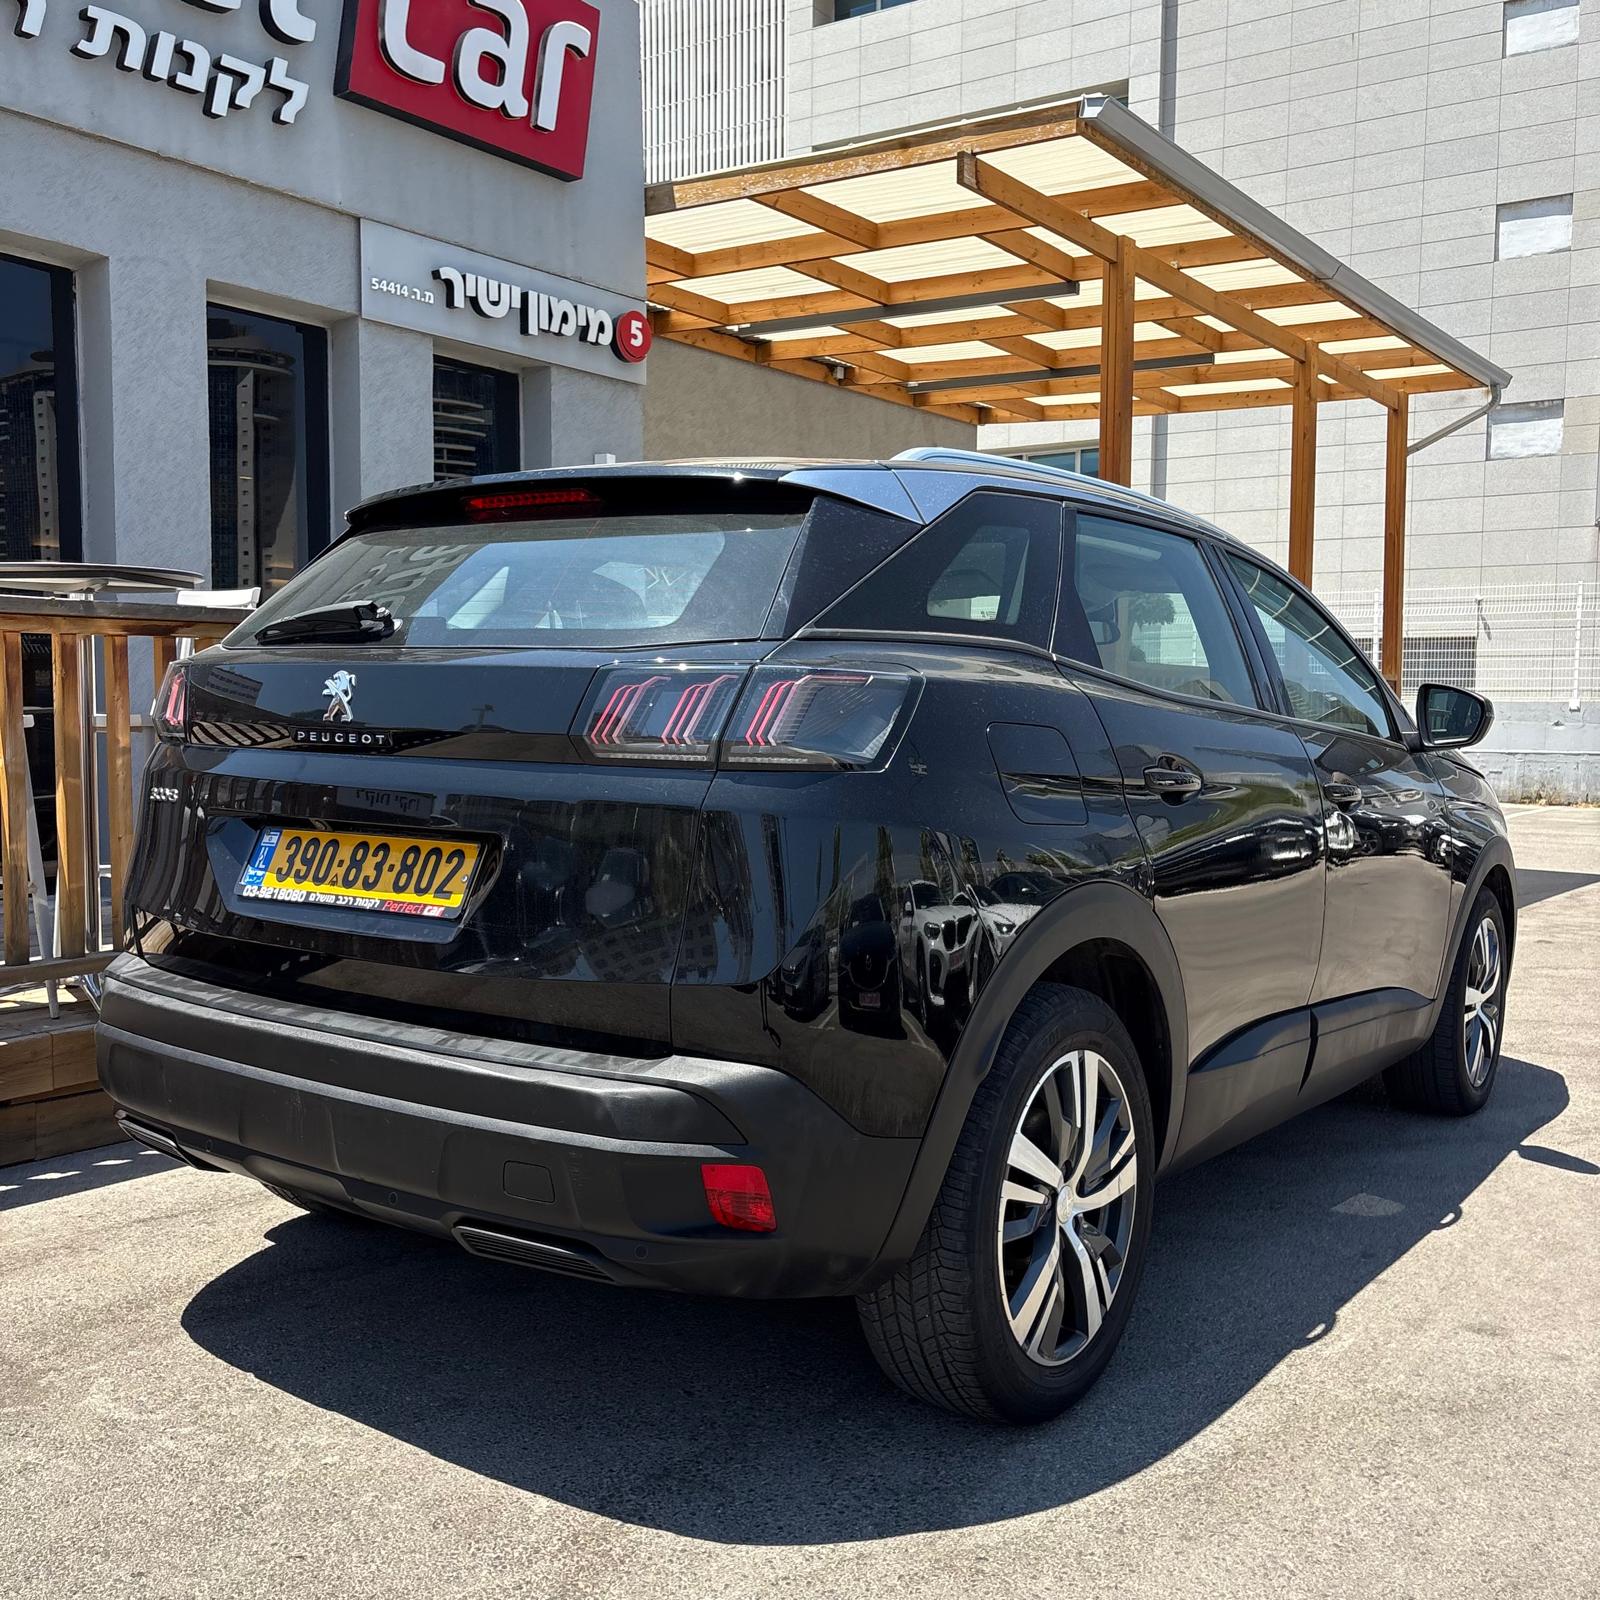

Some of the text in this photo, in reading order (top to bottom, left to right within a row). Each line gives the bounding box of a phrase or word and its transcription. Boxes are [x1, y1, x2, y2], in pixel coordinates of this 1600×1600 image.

[70, 4, 309, 125] לקנות
[371, 277, 409, 297] 54414
[431, 266, 644, 347] 5 מימון ישיר
[297, 731, 385, 745] PEUGEOT
[242, 885, 307, 903] 03-9218080
[308, 891, 380, 909] לקנות רכב מושלם
[383, 900, 445, 917] Perfect car
